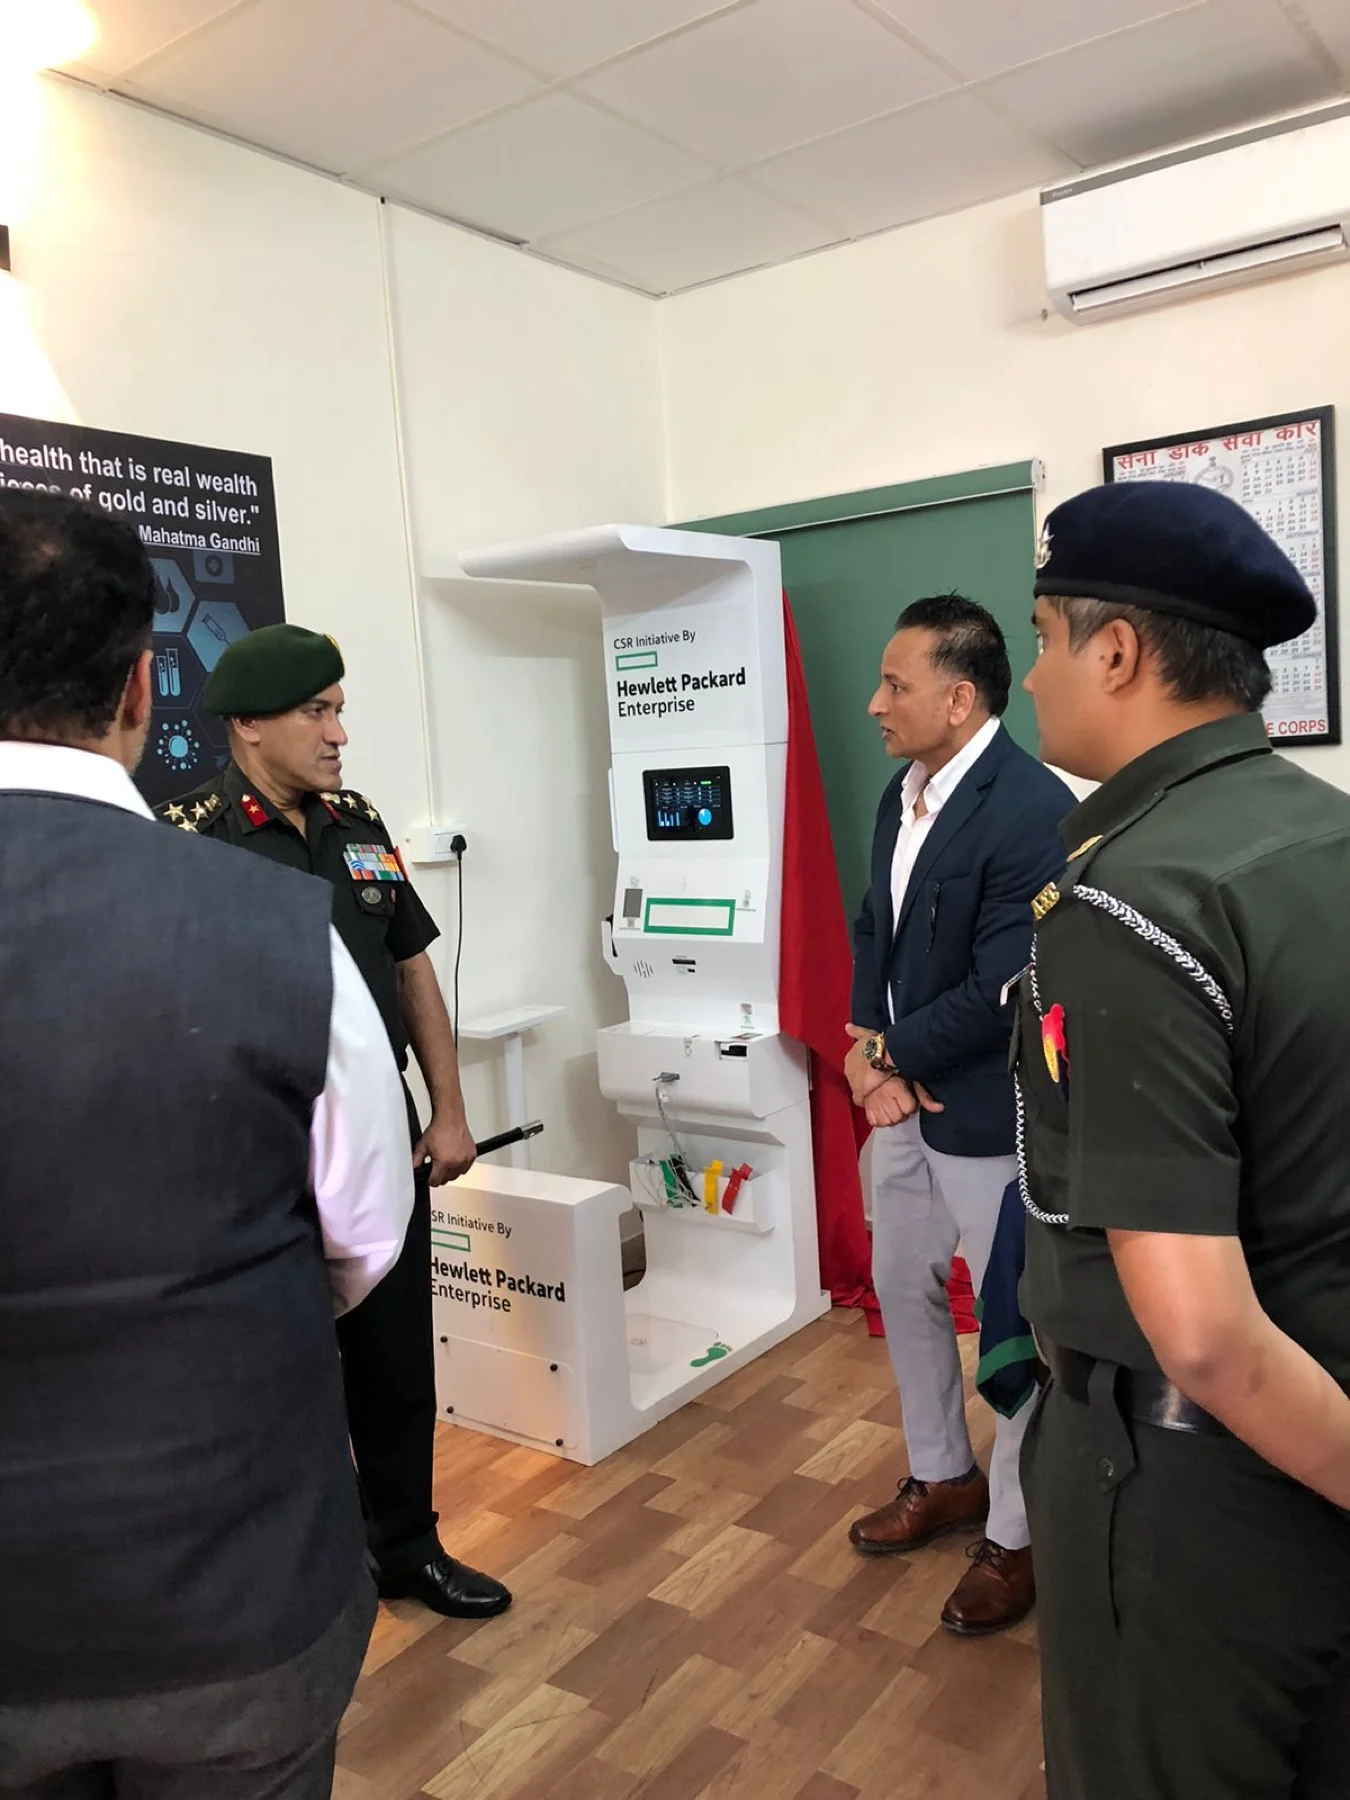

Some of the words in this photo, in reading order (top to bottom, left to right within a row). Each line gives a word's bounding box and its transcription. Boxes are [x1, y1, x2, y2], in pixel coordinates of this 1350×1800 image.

[0, 437, 73, 471] health
[79, 450, 123, 479] that
[128, 457, 147, 481] is
[153, 464, 190, 488] real
[196, 473, 258, 497] wealth
[99, 488, 146, 513] gold
[152, 496, 189, 518] and
[195, 499, 259, 525] silver."
[138, 524, 206, 548] Mahatma
[209, 532, 260, 553] Gandhi
[613, 637, 633, 650] CSR
[635, 632, 680, 648] Initiative
[682, 630, 696, 643] By
[617, 675, 677, 697] Hewlett
[682, 667, 746, 691] Packard
[618, 696, 695, 718] Enterprise
[1265, 722, 1275, 736] E
[1278, 719, 1326, 735] CORPS
[431, 1209, 445, 1223] SR
[447, 1212, 495, 1233] Initiative
[497, 1222, 512, 1239] By
[431, 1278, 512, 1312] Enterprise
[496, 1268, 566, 1303] Packard
